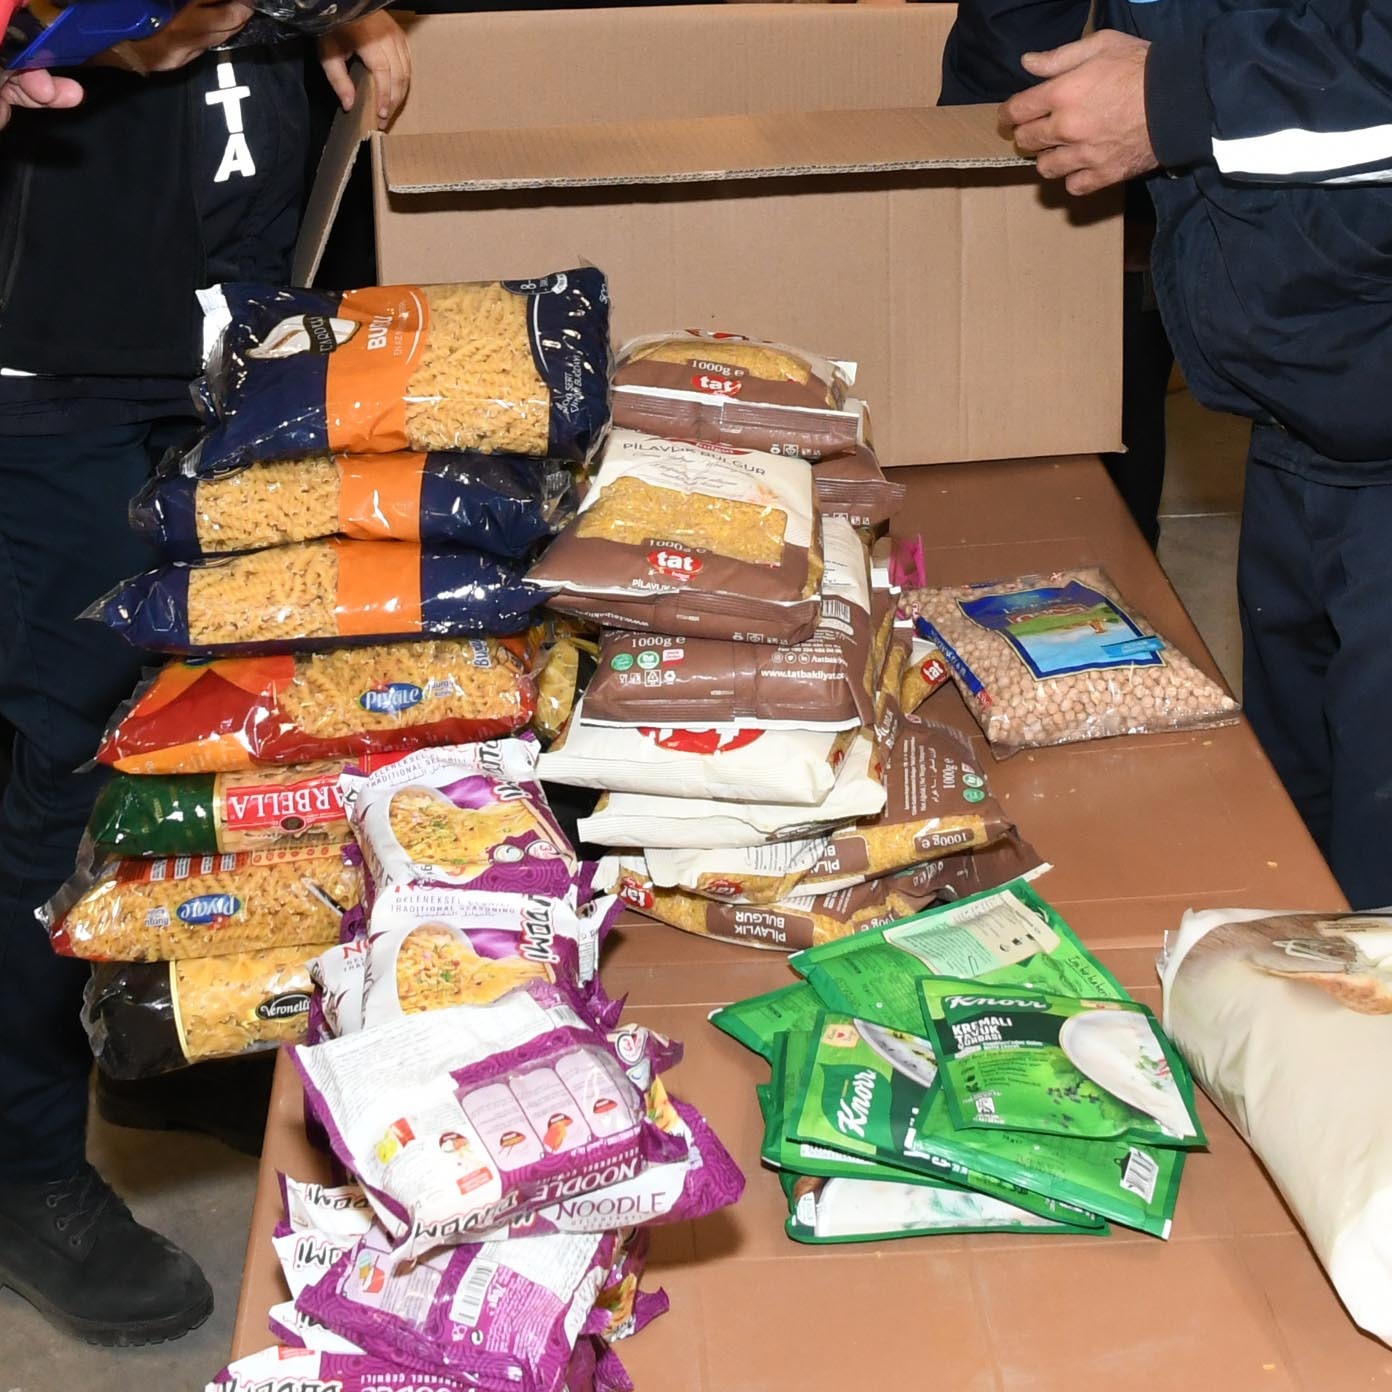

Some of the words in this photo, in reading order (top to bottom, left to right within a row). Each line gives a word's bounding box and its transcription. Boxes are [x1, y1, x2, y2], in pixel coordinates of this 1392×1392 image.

[691, 360, 732, 376] 1000g
[699, 374, 735, 392] tat
[656, 549, 695, 573] tat
[632, 636, 673, 650] 1000g
[943, 765, 958, 789] 1000g
[735, 911, 786, 929] BULGUR
[734, 924, 787, 944] PİLAVLIK
[945, 995, 1048, 1009] Knorr
[835, 1068, 878, 1138] Knorr
[534, 1158, 638, 1201] NOODLE
[555, 1192, 668, 1220] NOODLE
